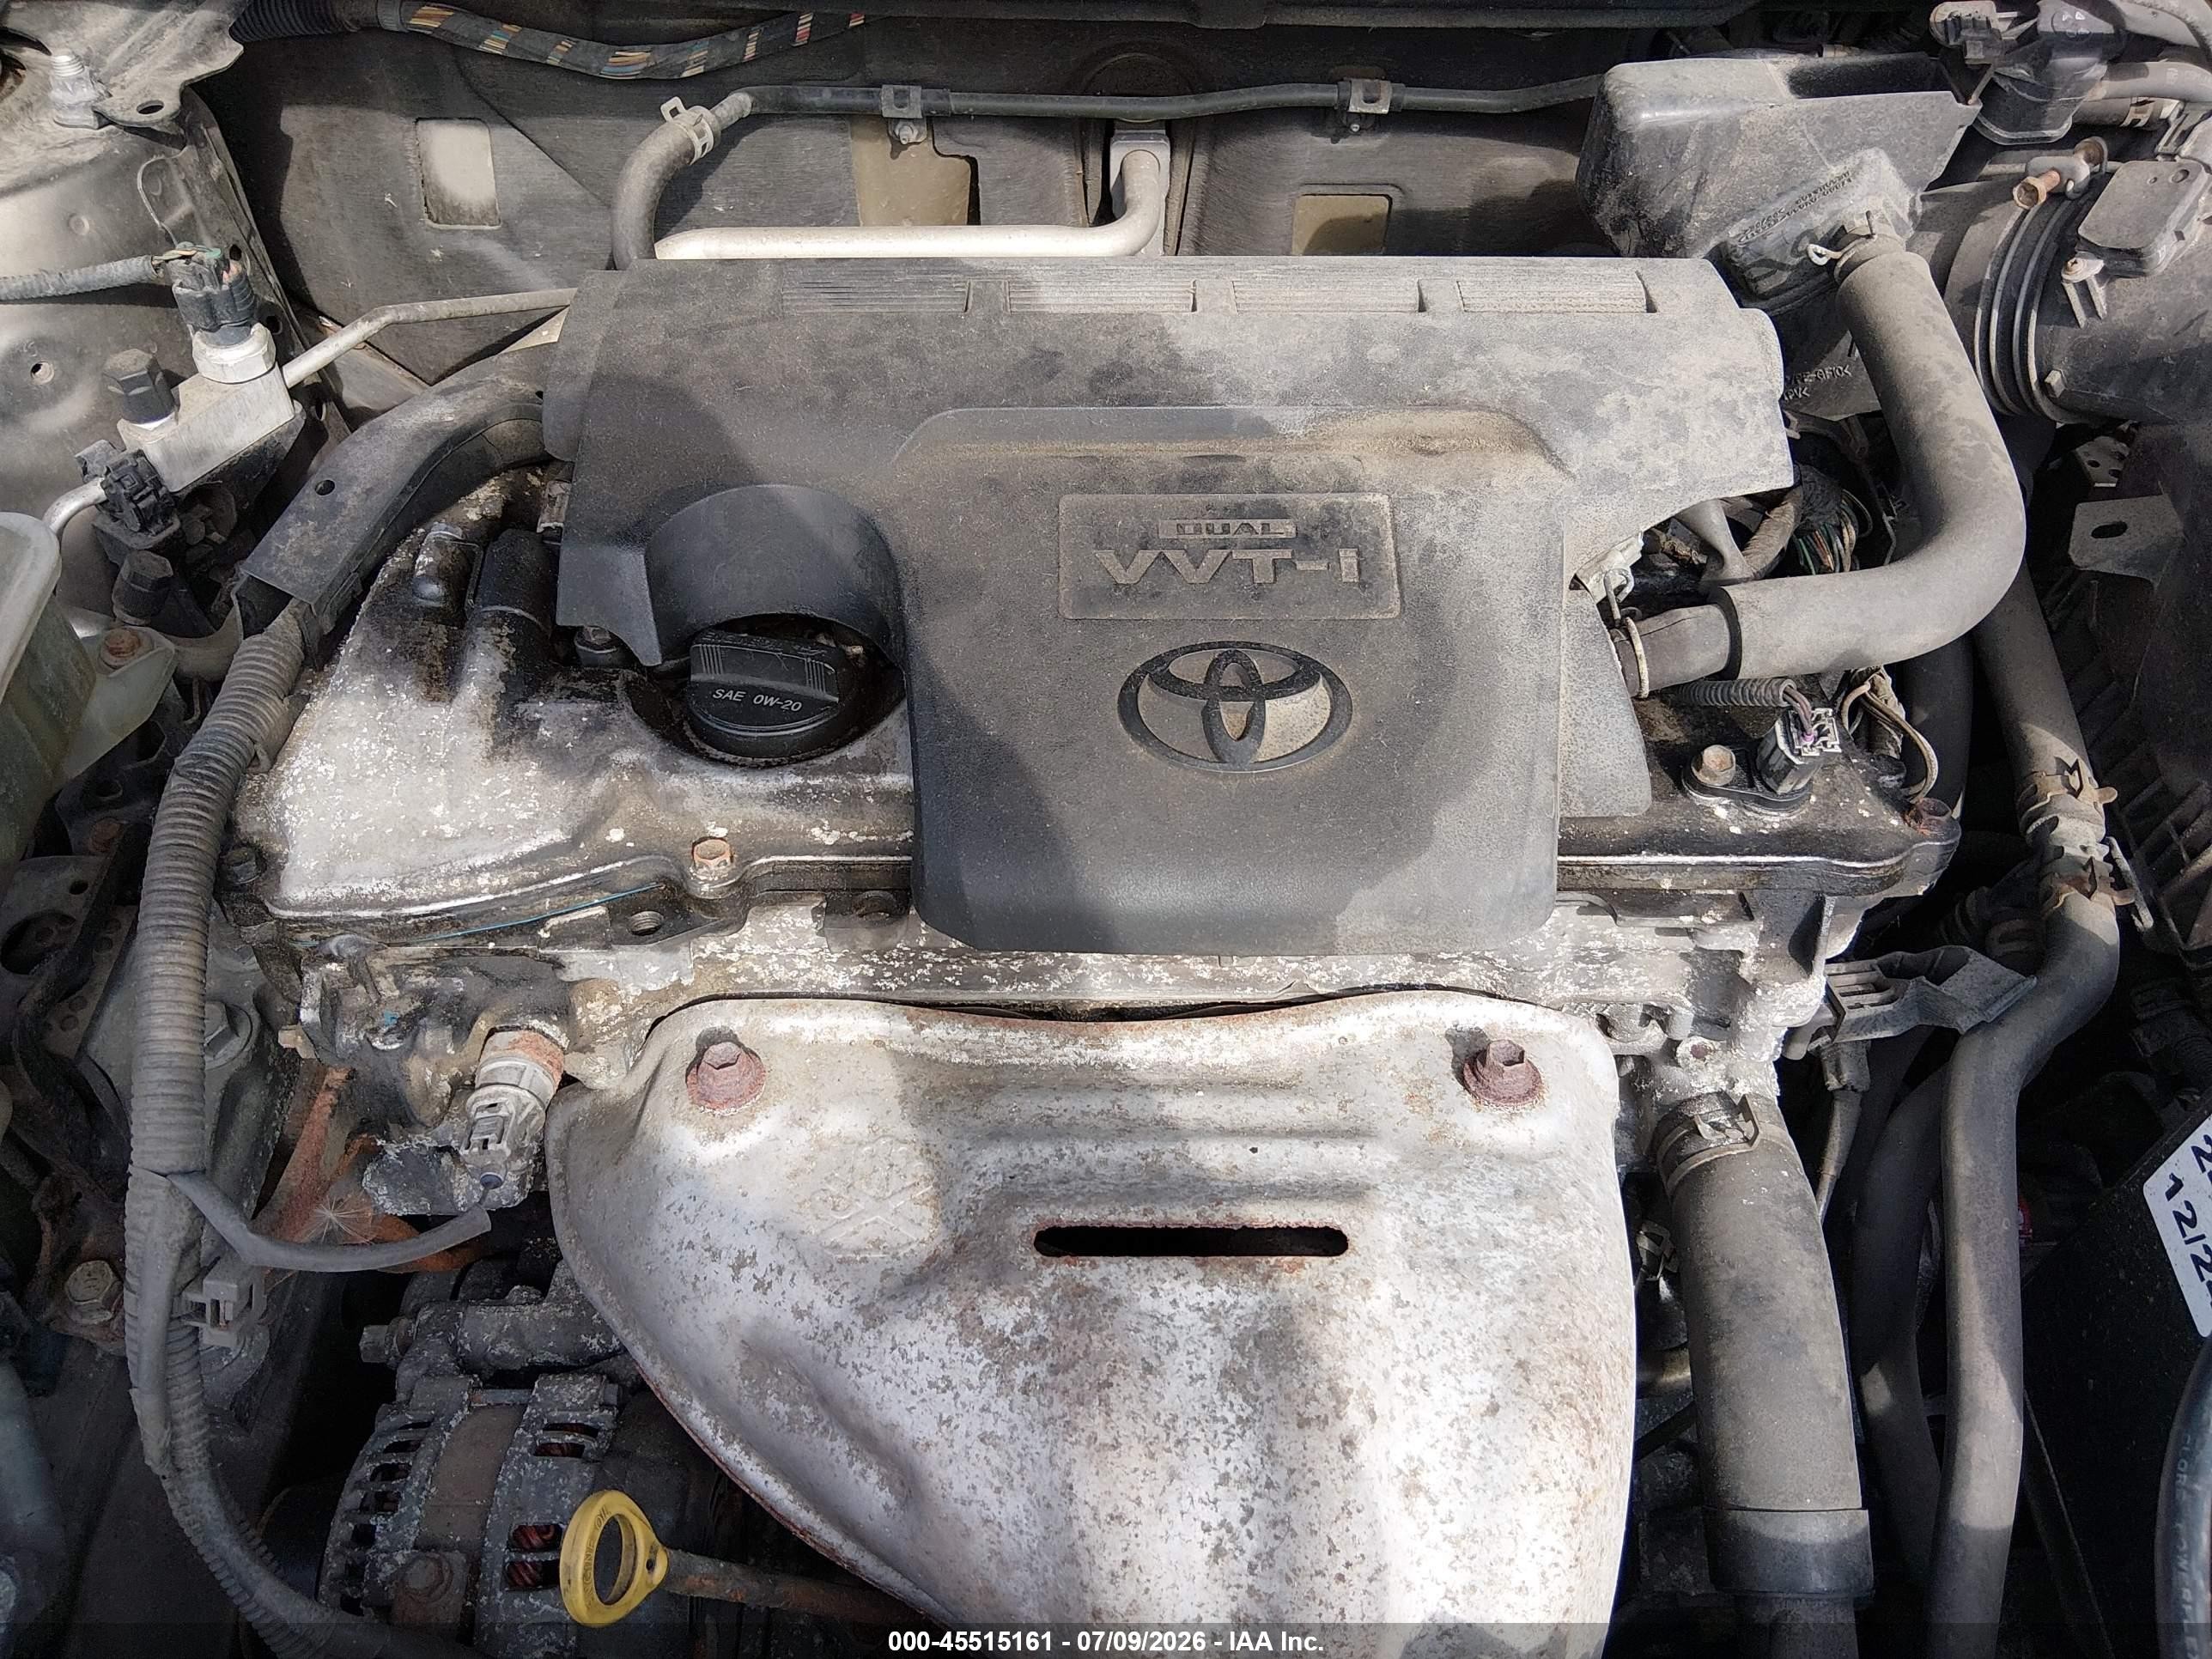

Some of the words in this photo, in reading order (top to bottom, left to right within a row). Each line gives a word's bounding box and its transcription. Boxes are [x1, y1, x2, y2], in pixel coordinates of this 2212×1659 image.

[1176, 521, 1285, 536] DUAL
[713, 689, 746, 702] SAE
[753, 694, 802, 712] 0W-20
